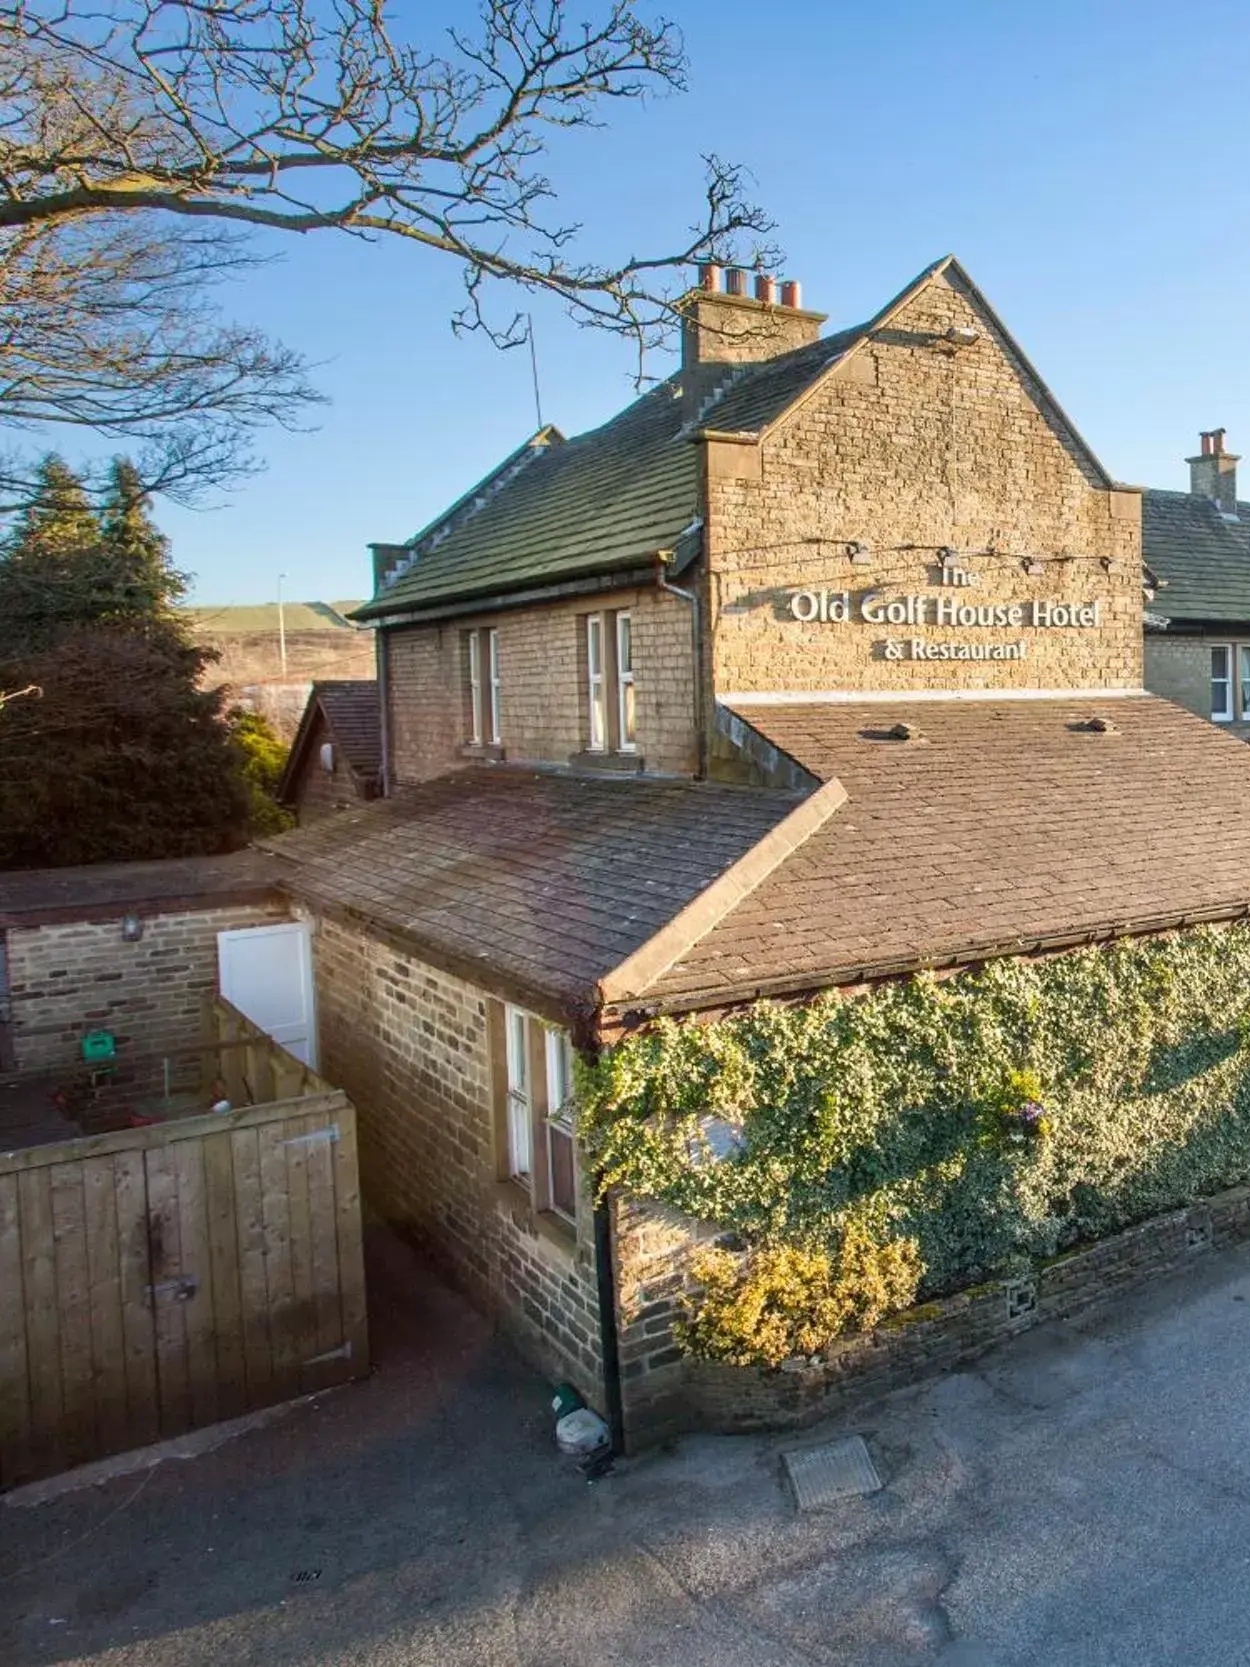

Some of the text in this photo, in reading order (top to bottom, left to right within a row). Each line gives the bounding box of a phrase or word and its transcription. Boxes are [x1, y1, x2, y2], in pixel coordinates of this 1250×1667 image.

[791, 591, 1100, 627] Old Golf House Hotel
[884, 638, 1027, 661] & Restaurant
